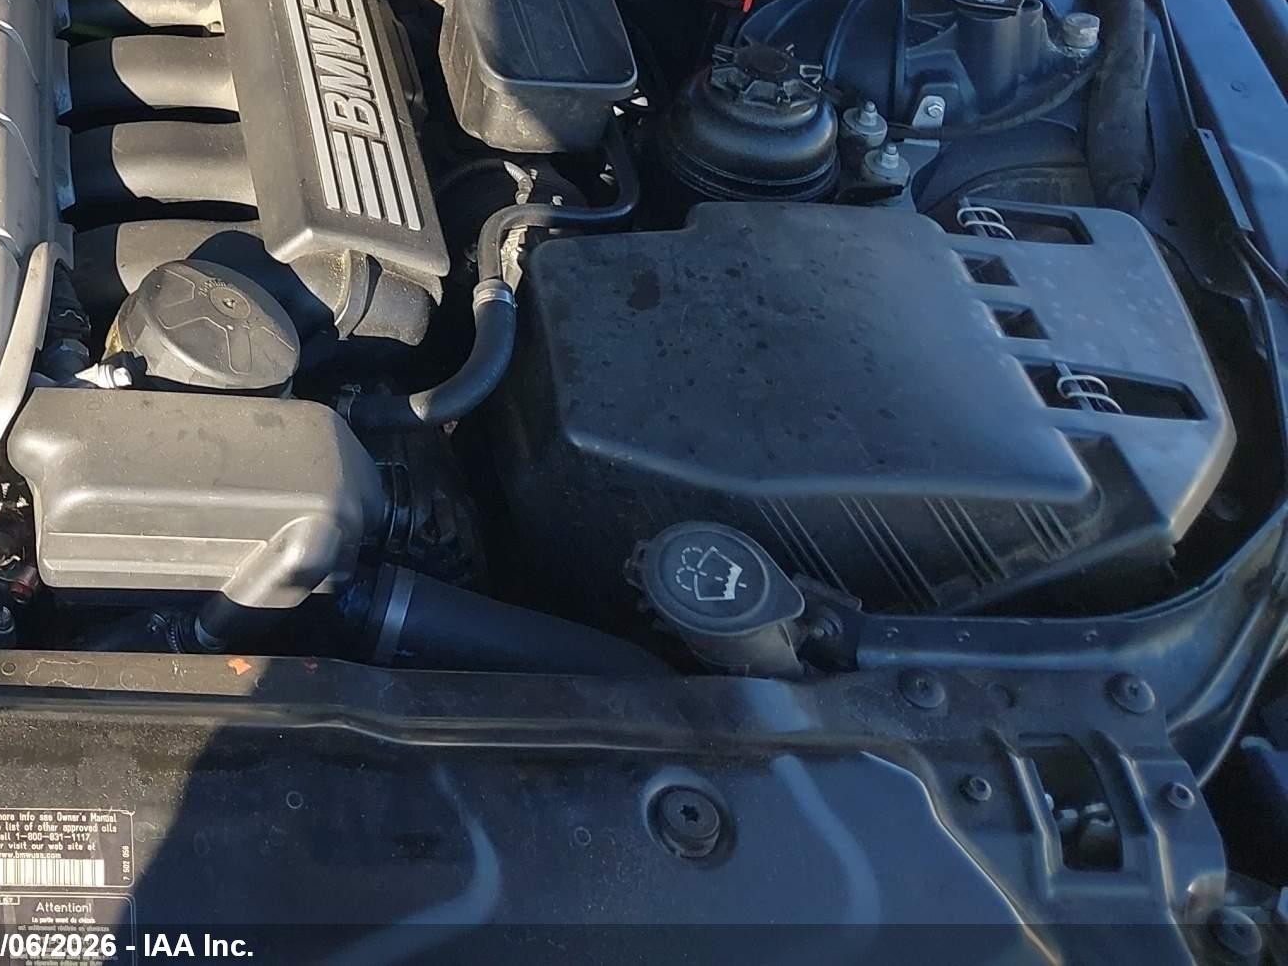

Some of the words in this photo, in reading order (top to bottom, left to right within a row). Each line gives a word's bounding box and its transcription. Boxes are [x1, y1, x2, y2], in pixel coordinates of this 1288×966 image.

[306, 11, 385, 139] BMW
[19, 812, 35, 821] info
[39, 814, 52, 822] see
[56, 812, 87, 822] Owner's
[90, 812, 117, 822] Manual
[5, 822, 20, 831] list
[24, 822, 33, 831] of
[38, 822, 58, 832] other
[62, 823, 98, 833] approved
[102, 824, 117, 832] oils
[15, 833, 90, 841] 1-800-831-1117
[8, 842, 27, 850] visit
[48, 842, 63, 851] web
[68, 843, 83, 851] site
[87, 843, 96, 851] at
[36, 902, 92, 913] Attention!
